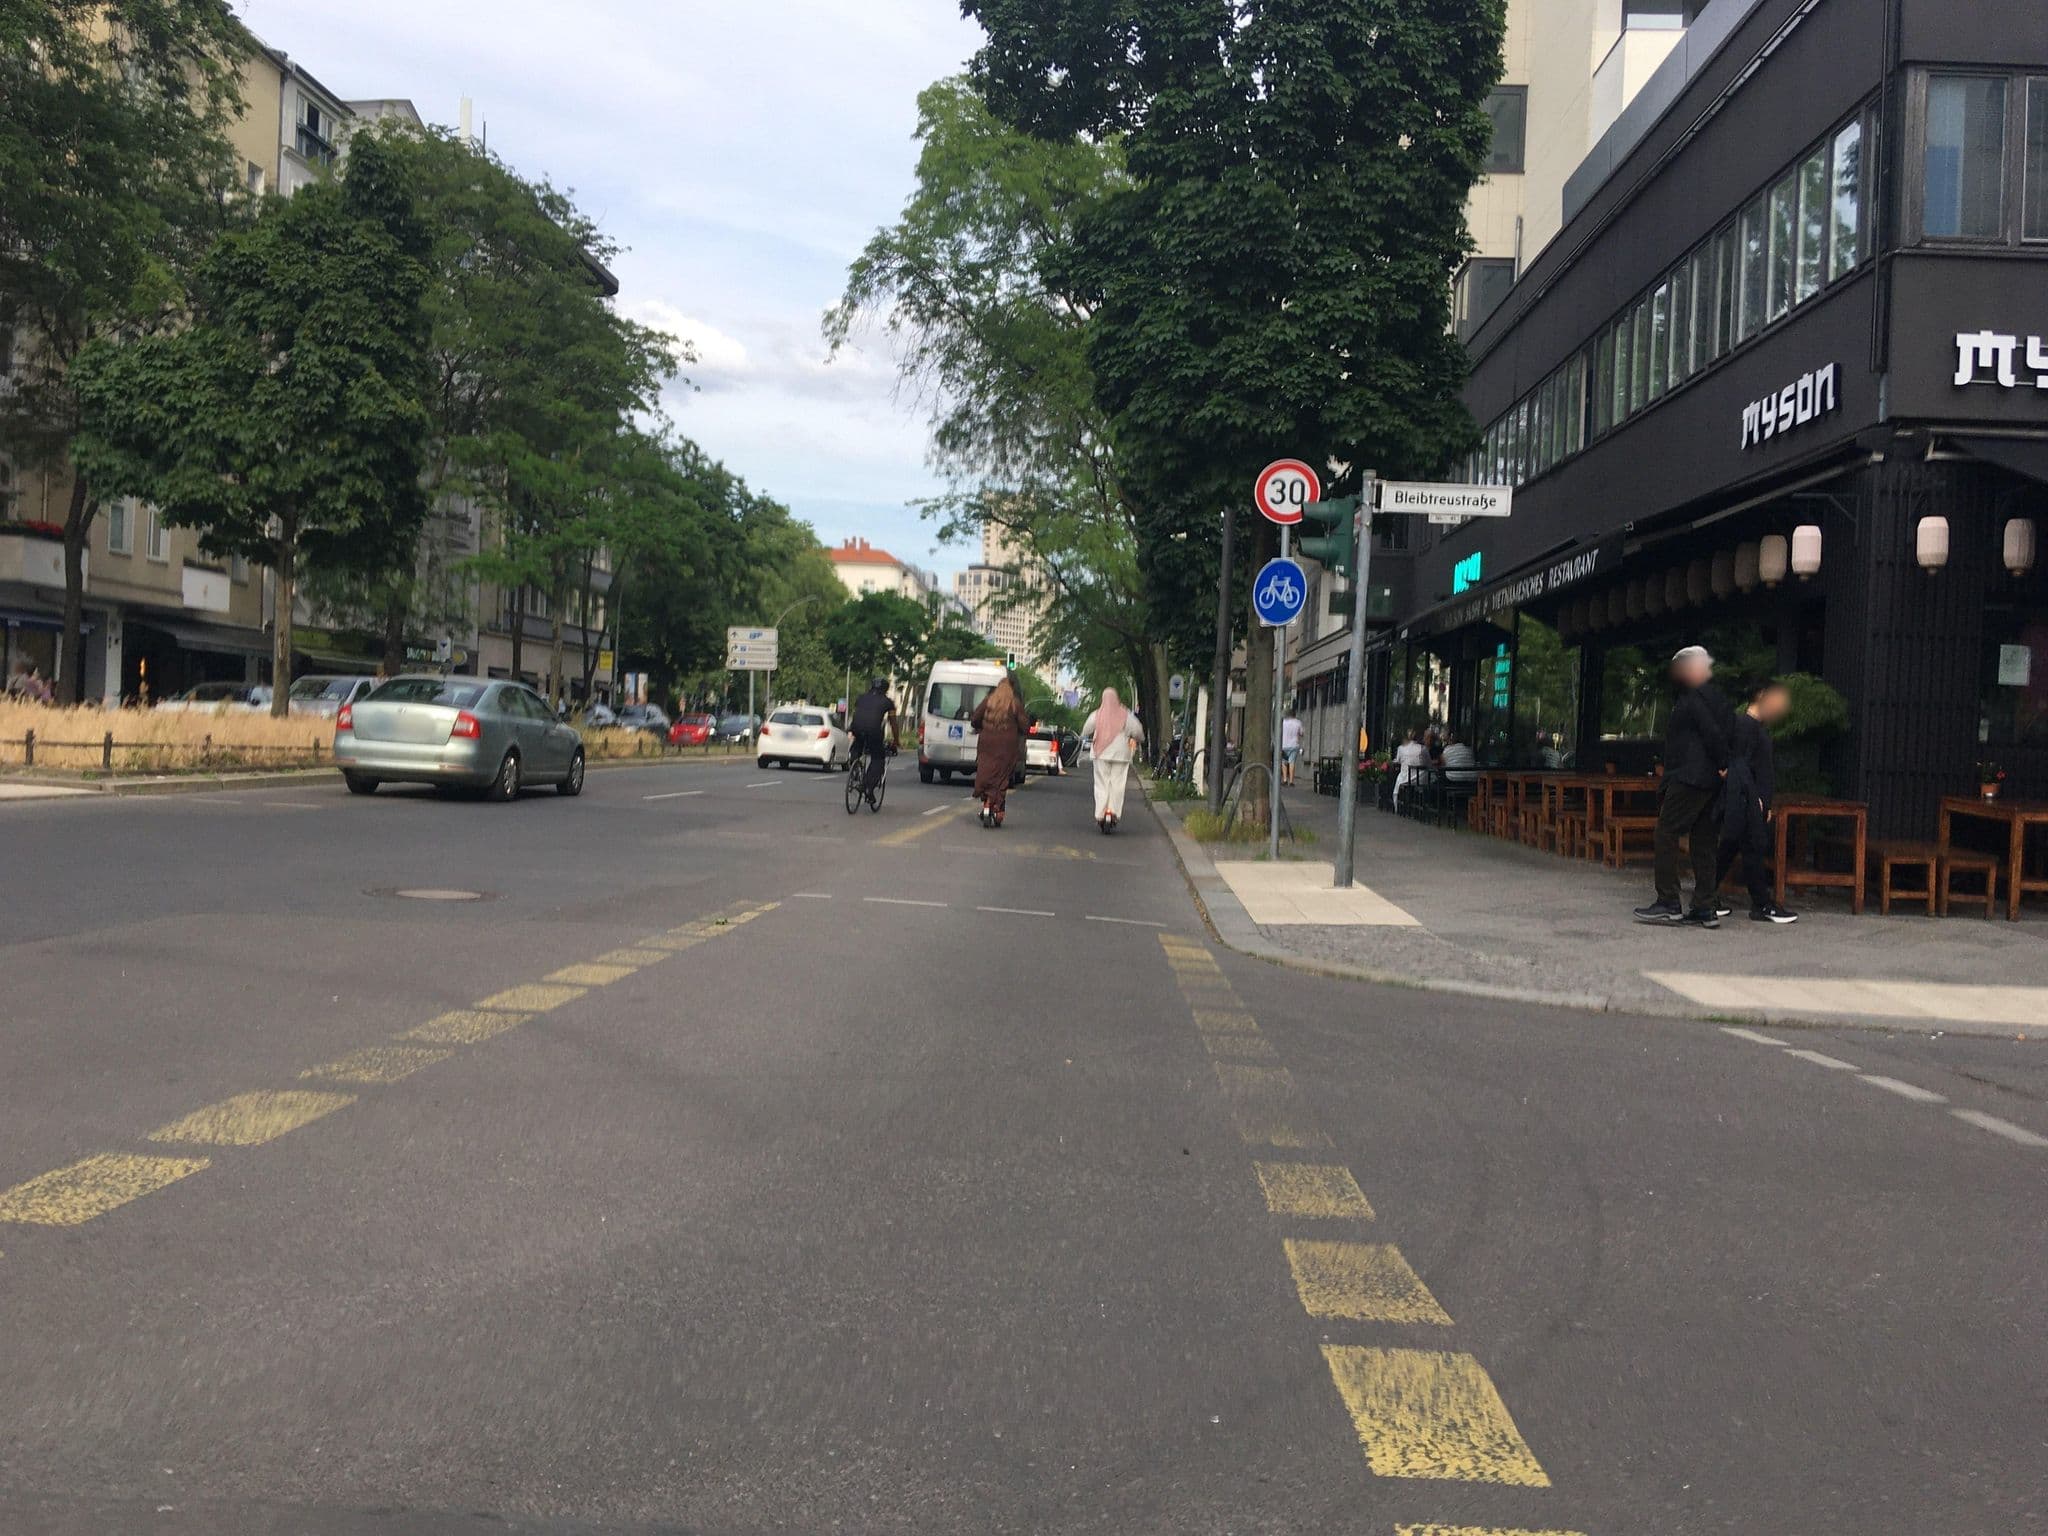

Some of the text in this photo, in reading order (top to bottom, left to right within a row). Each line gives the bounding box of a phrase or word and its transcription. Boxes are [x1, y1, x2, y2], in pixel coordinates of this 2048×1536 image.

[1270, 478, 1305, 505] 30
[1395, 490, 1497, 510] Bleibtreustraße
[1548, 548, 1599, 591] RESTAURANT
